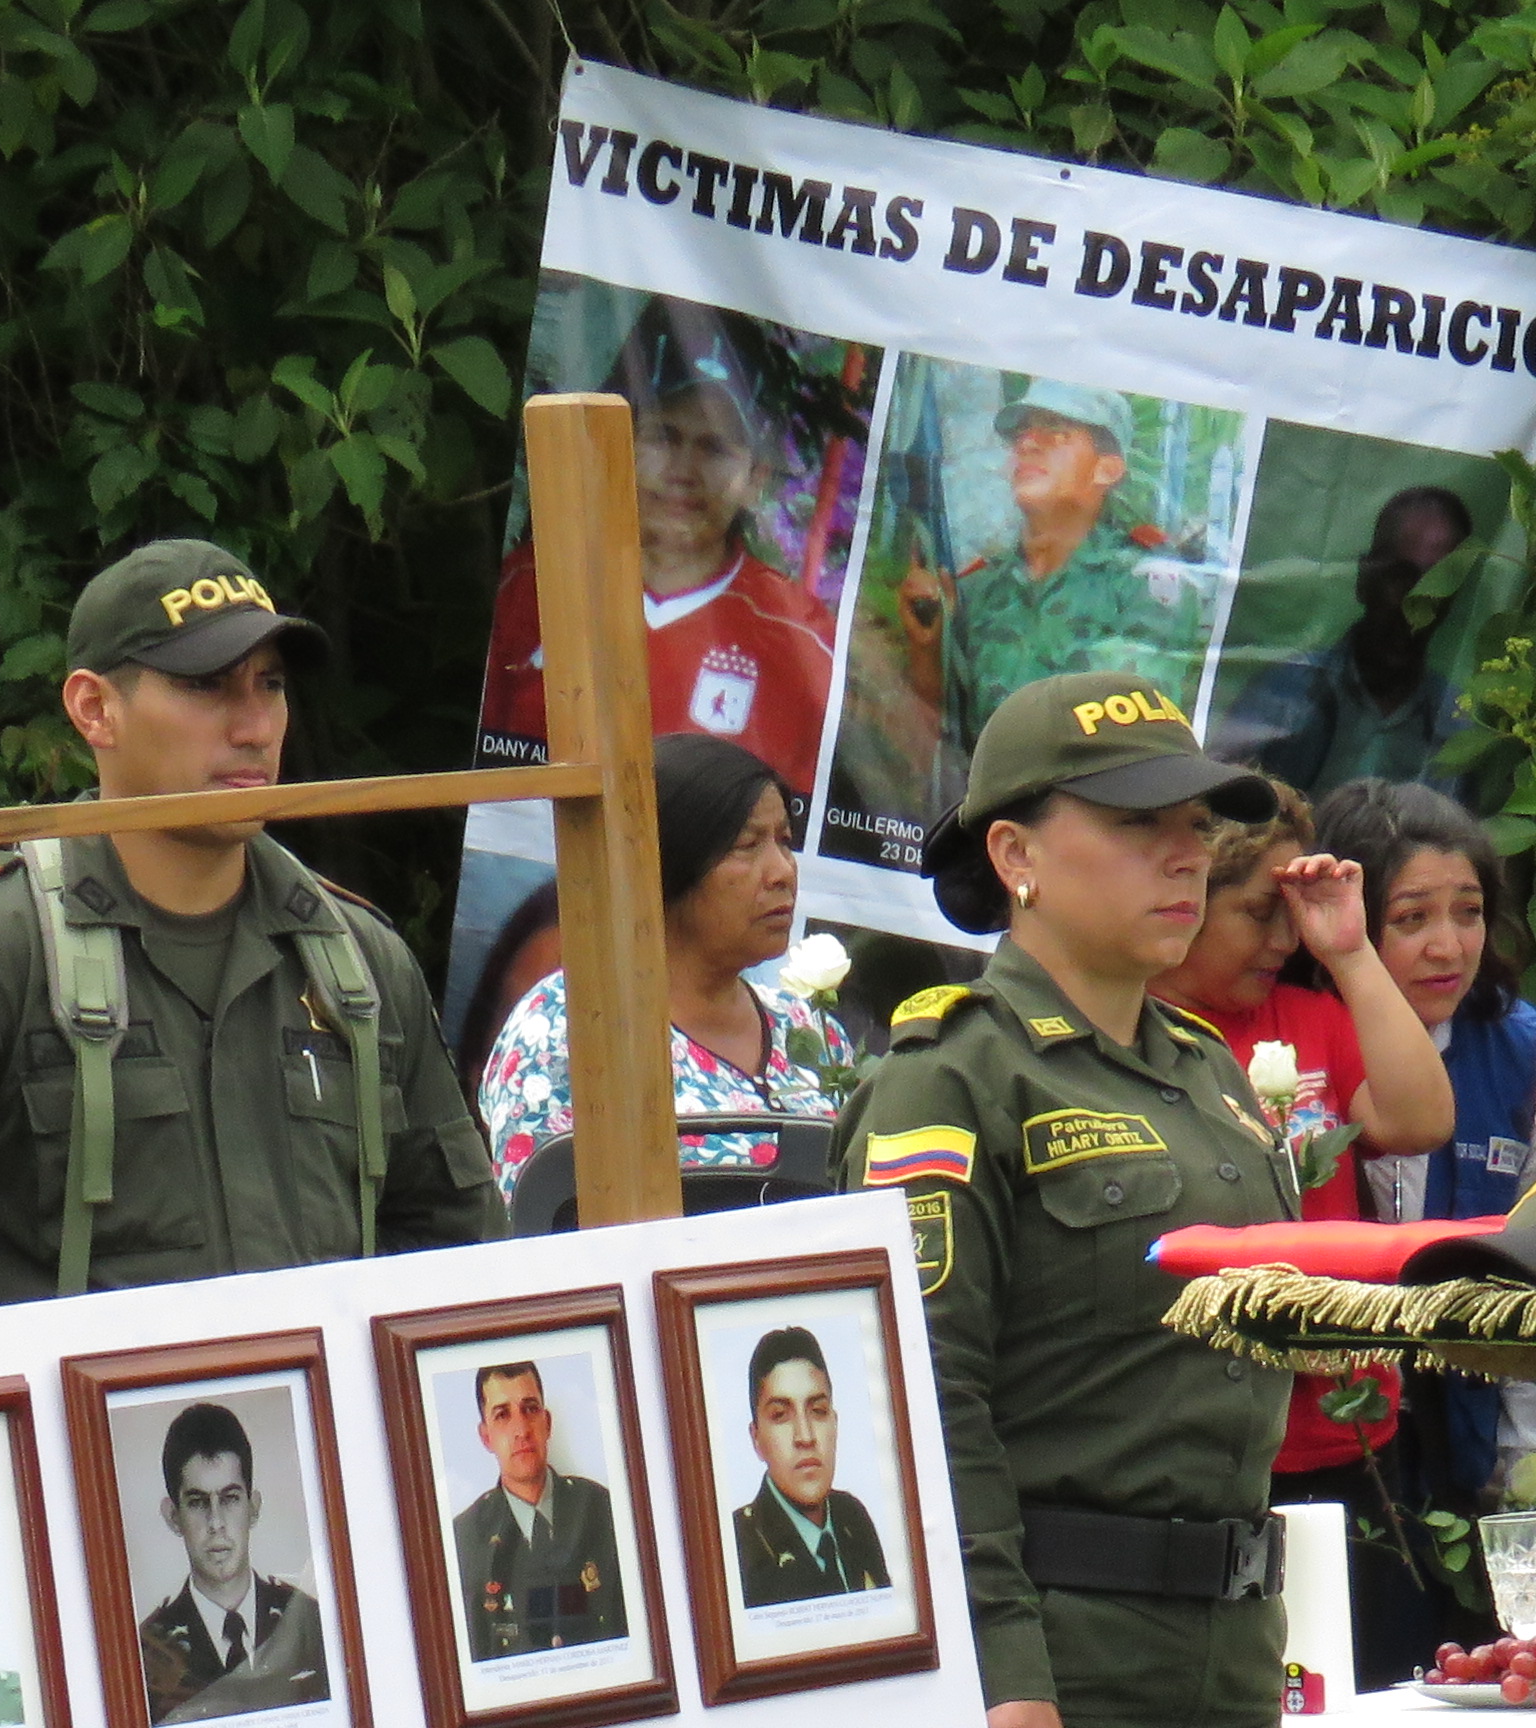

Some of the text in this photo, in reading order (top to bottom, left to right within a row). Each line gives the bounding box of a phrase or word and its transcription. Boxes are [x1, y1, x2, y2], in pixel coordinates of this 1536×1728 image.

[559, 118, 925, 264] VICTIMAS
[942, 206, 1057, 288] DE
[482, 734, 529, 758] DANY
[827, 807, 925, 842] GUILLERMO
[879, 842, 901, 860] 23
[1046, 1132, 1100, 1158] HILARY
